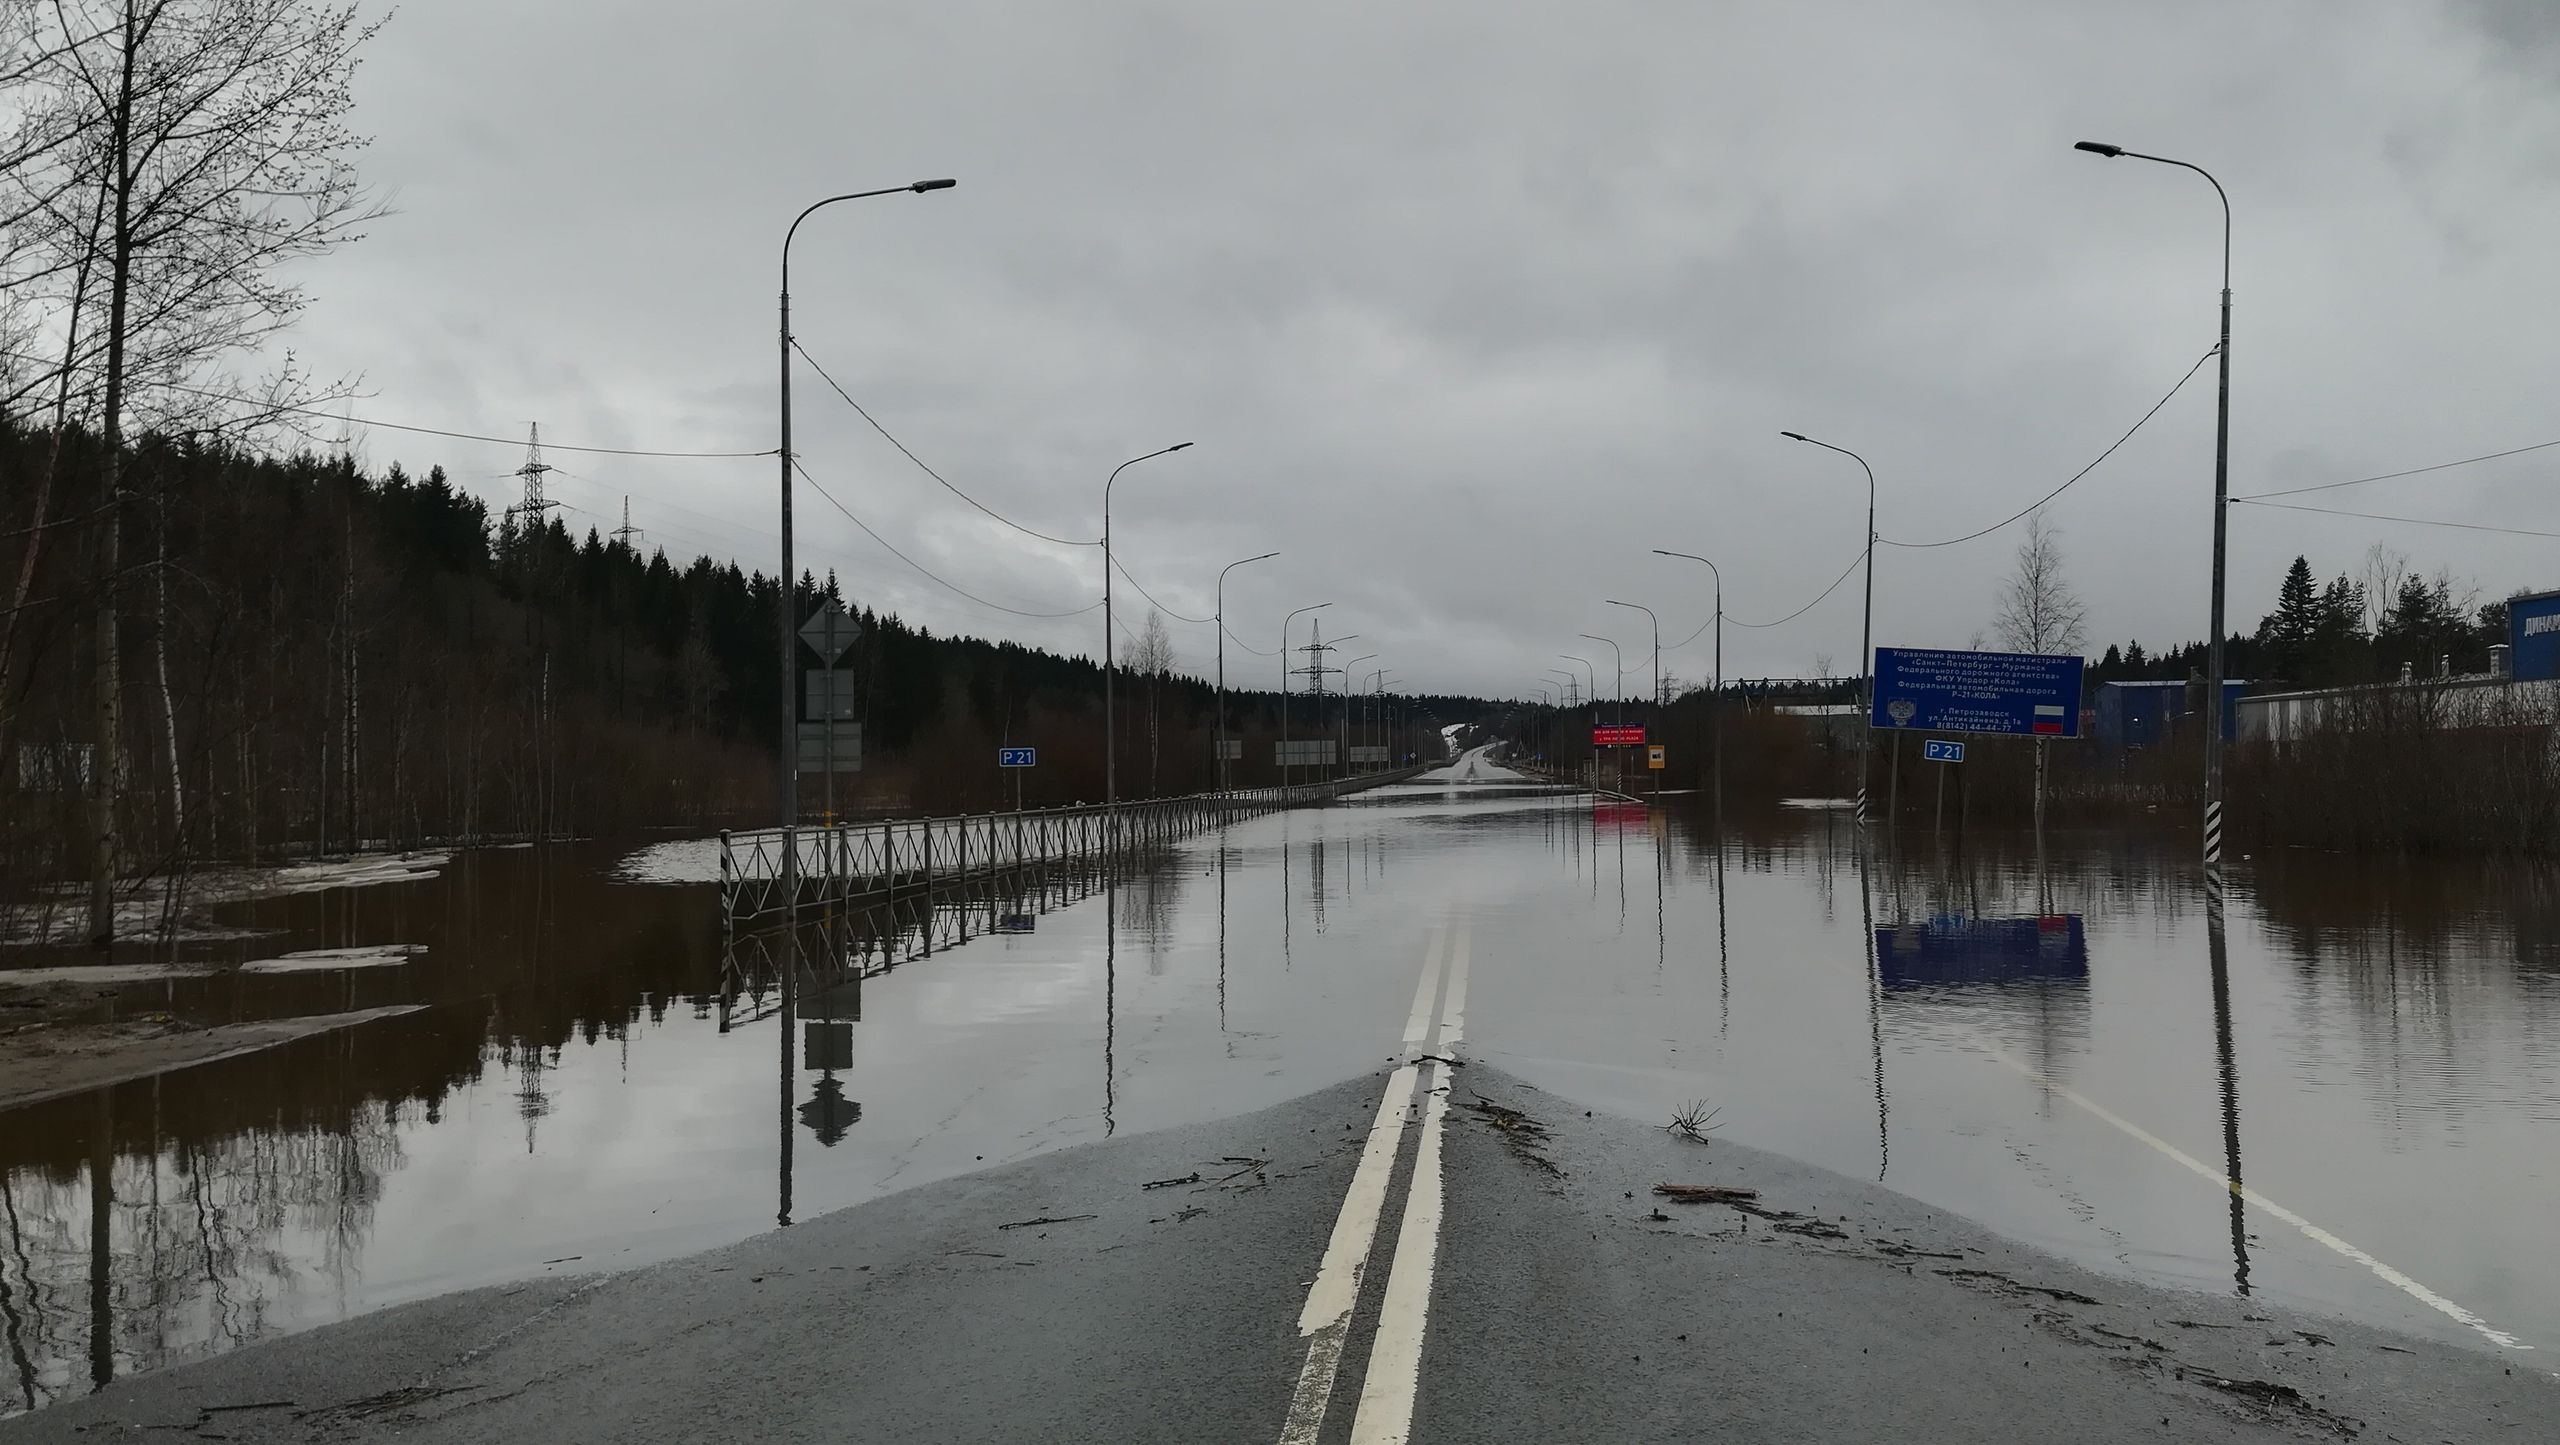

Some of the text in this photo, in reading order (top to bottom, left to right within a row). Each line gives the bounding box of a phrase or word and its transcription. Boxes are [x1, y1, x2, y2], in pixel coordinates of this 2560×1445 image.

[1893, 650, 2068, 665] Управление автомобильной магистрали
[1897, 665, 1960, 675] Федерального
[1961, 669, 2010, 677] дорожного
[2001, 663, 2046, 671] Мурманск
[1956, 676, 1989, 685] Упрдор
[1990, 677, 2020, 685] «Кола»
[1898, 681, 2057, 696] Федеральная автомобильная дорога
[1940, 707, 2010, 717] г. Петрозаводск
[1936, 722, 1968, 730] 8(8142)
[1017, 752, 1032, 764] 21
[1944, 745, 1960, 759] 21
